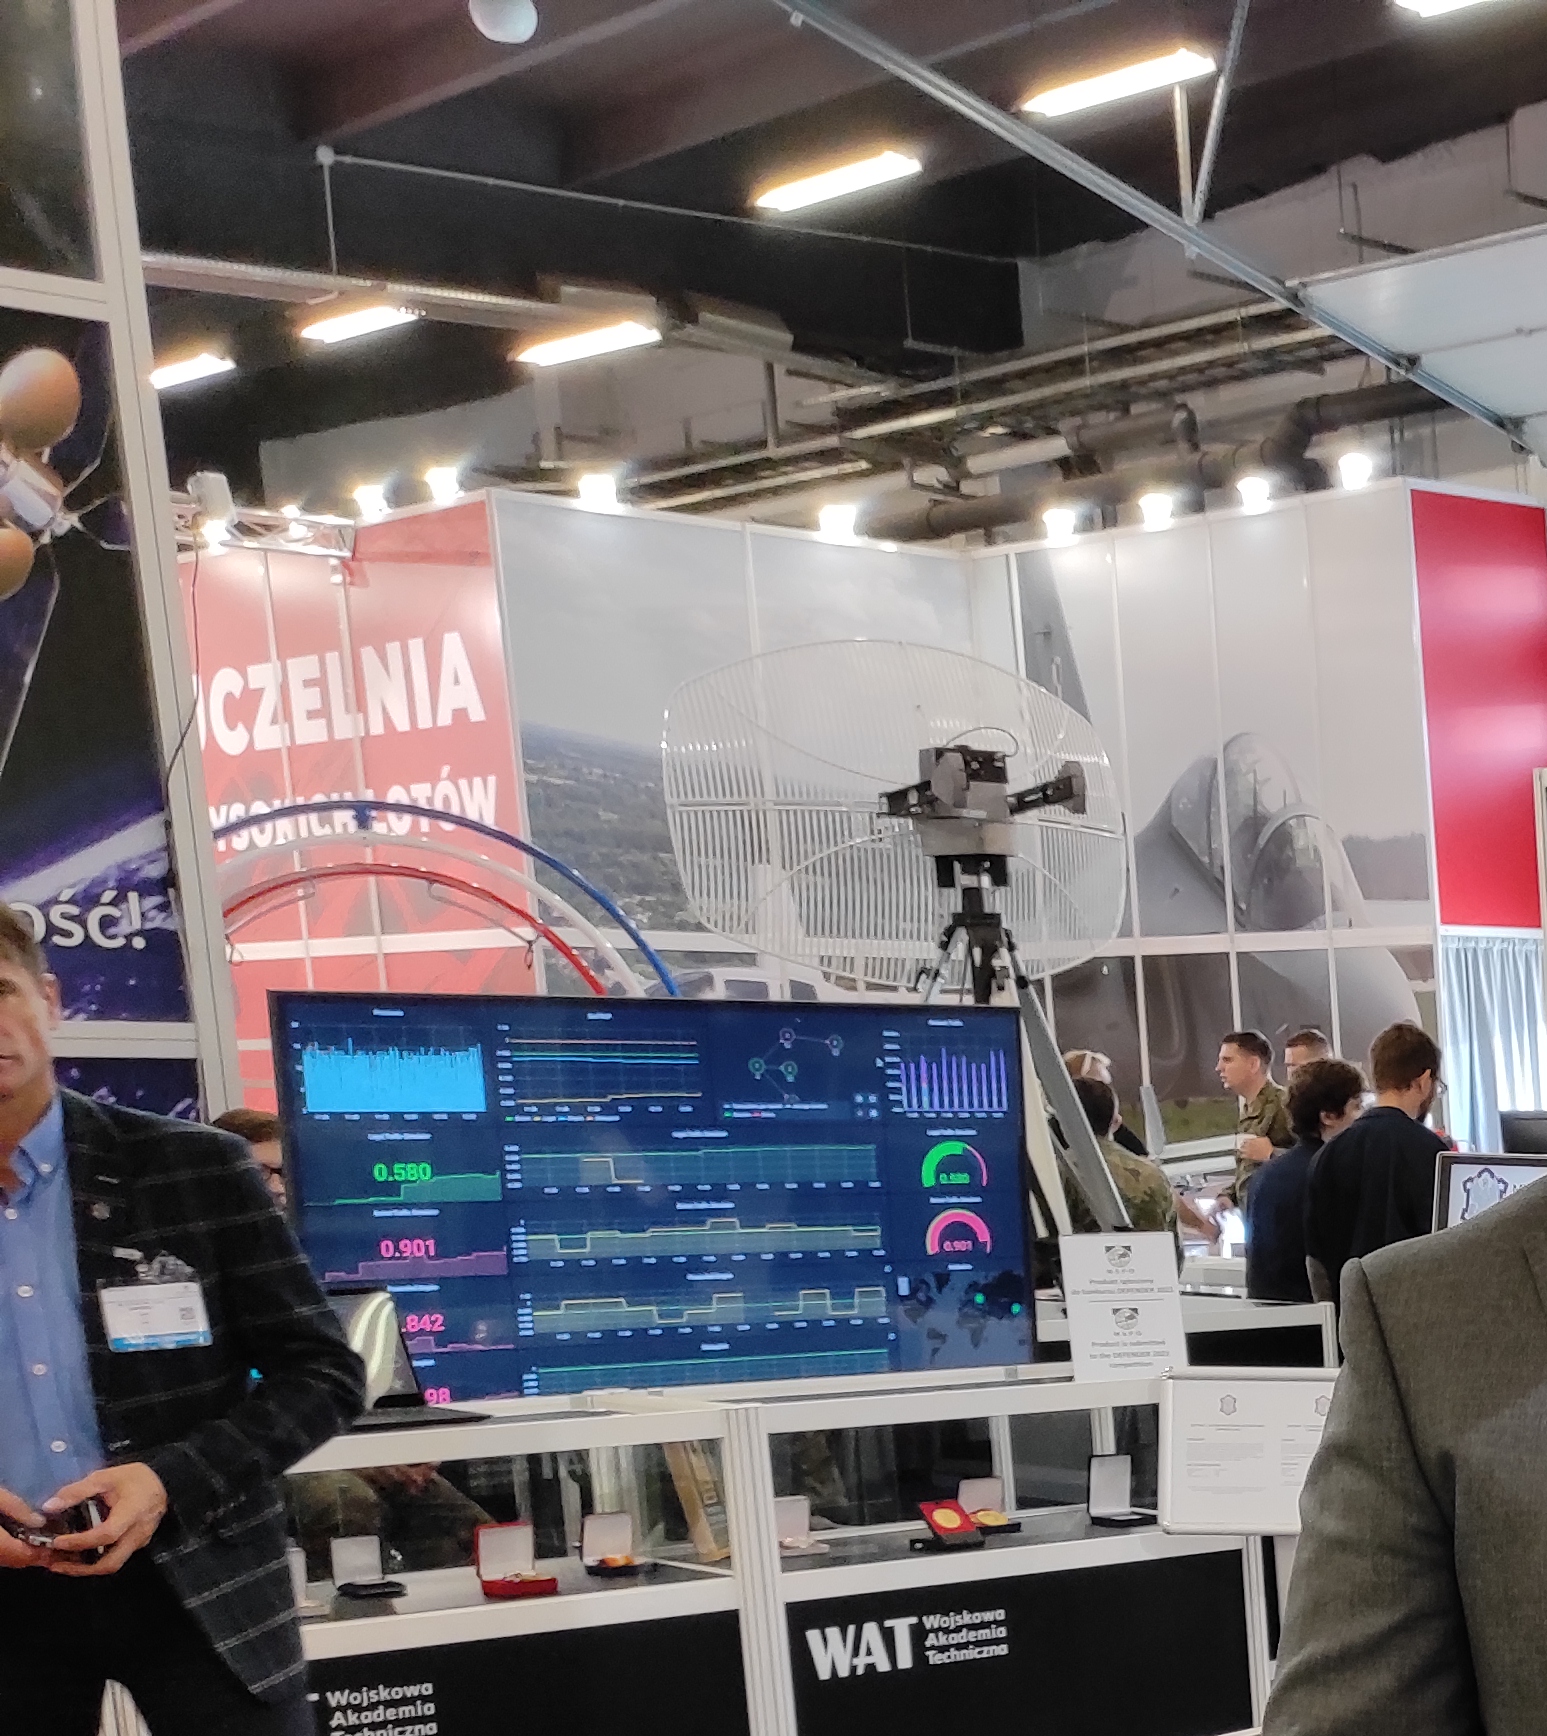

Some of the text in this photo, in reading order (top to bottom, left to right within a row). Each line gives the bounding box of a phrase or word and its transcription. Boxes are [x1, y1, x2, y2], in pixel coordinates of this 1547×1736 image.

[373, 1163, 432, 1181] 0.580
[380, 1239, 436, 1258] 0.901
[922, 1609, 1006, 1630] Wojskowa
[924, 1624, 1008, 1647] Akademia
[805, 1616, 919, 1680] WAT
[924, 1644, 1009, 1665] Techniczna
[325, 1682, 433, 1708] Wojskowa
[329, 1700, 436, 1728] Akademia
